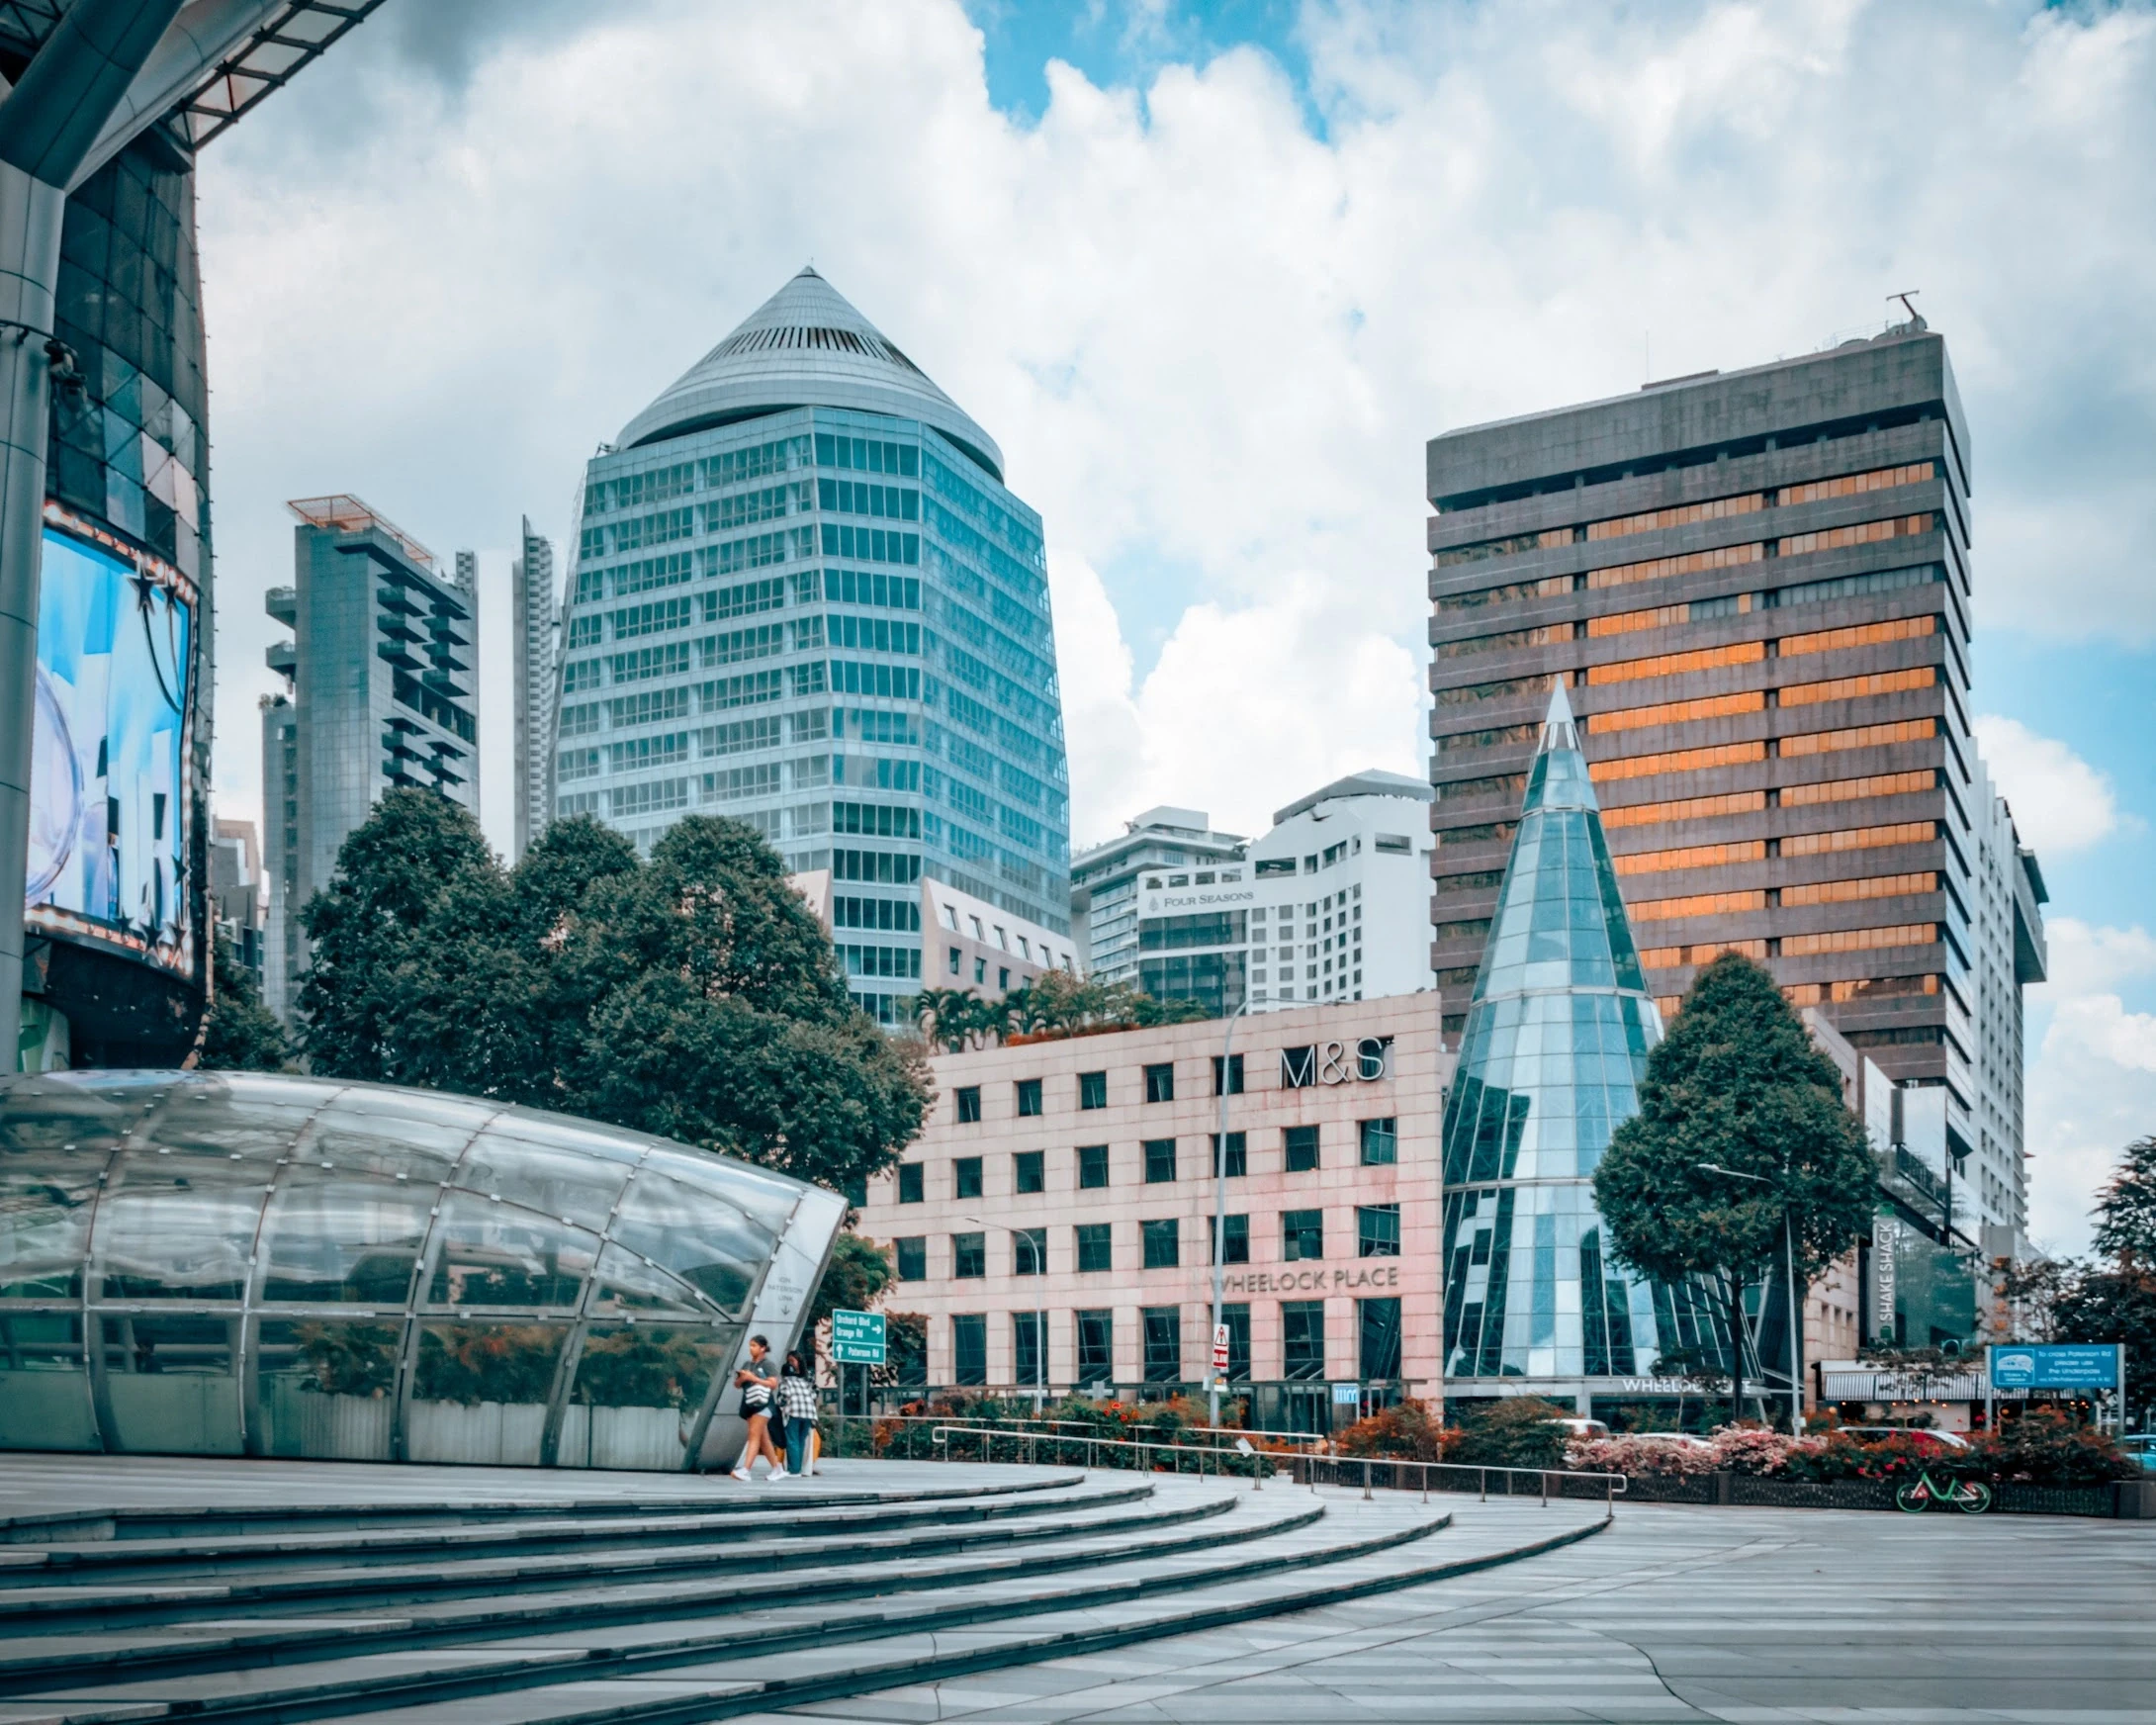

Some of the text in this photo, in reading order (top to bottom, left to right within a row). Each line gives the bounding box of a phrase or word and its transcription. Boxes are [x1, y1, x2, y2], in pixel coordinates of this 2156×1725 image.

[1164, 891, 1254, 908] FOUR SEASONS
[1279, 1037, 1385, 1090] M&S
[1334, 1266, 1398, 1289] PLACE
[1879, 1223, 1894, 1321] SHAKE SHACK
[1622, 1378, 1710, 1394] WHEELOC
